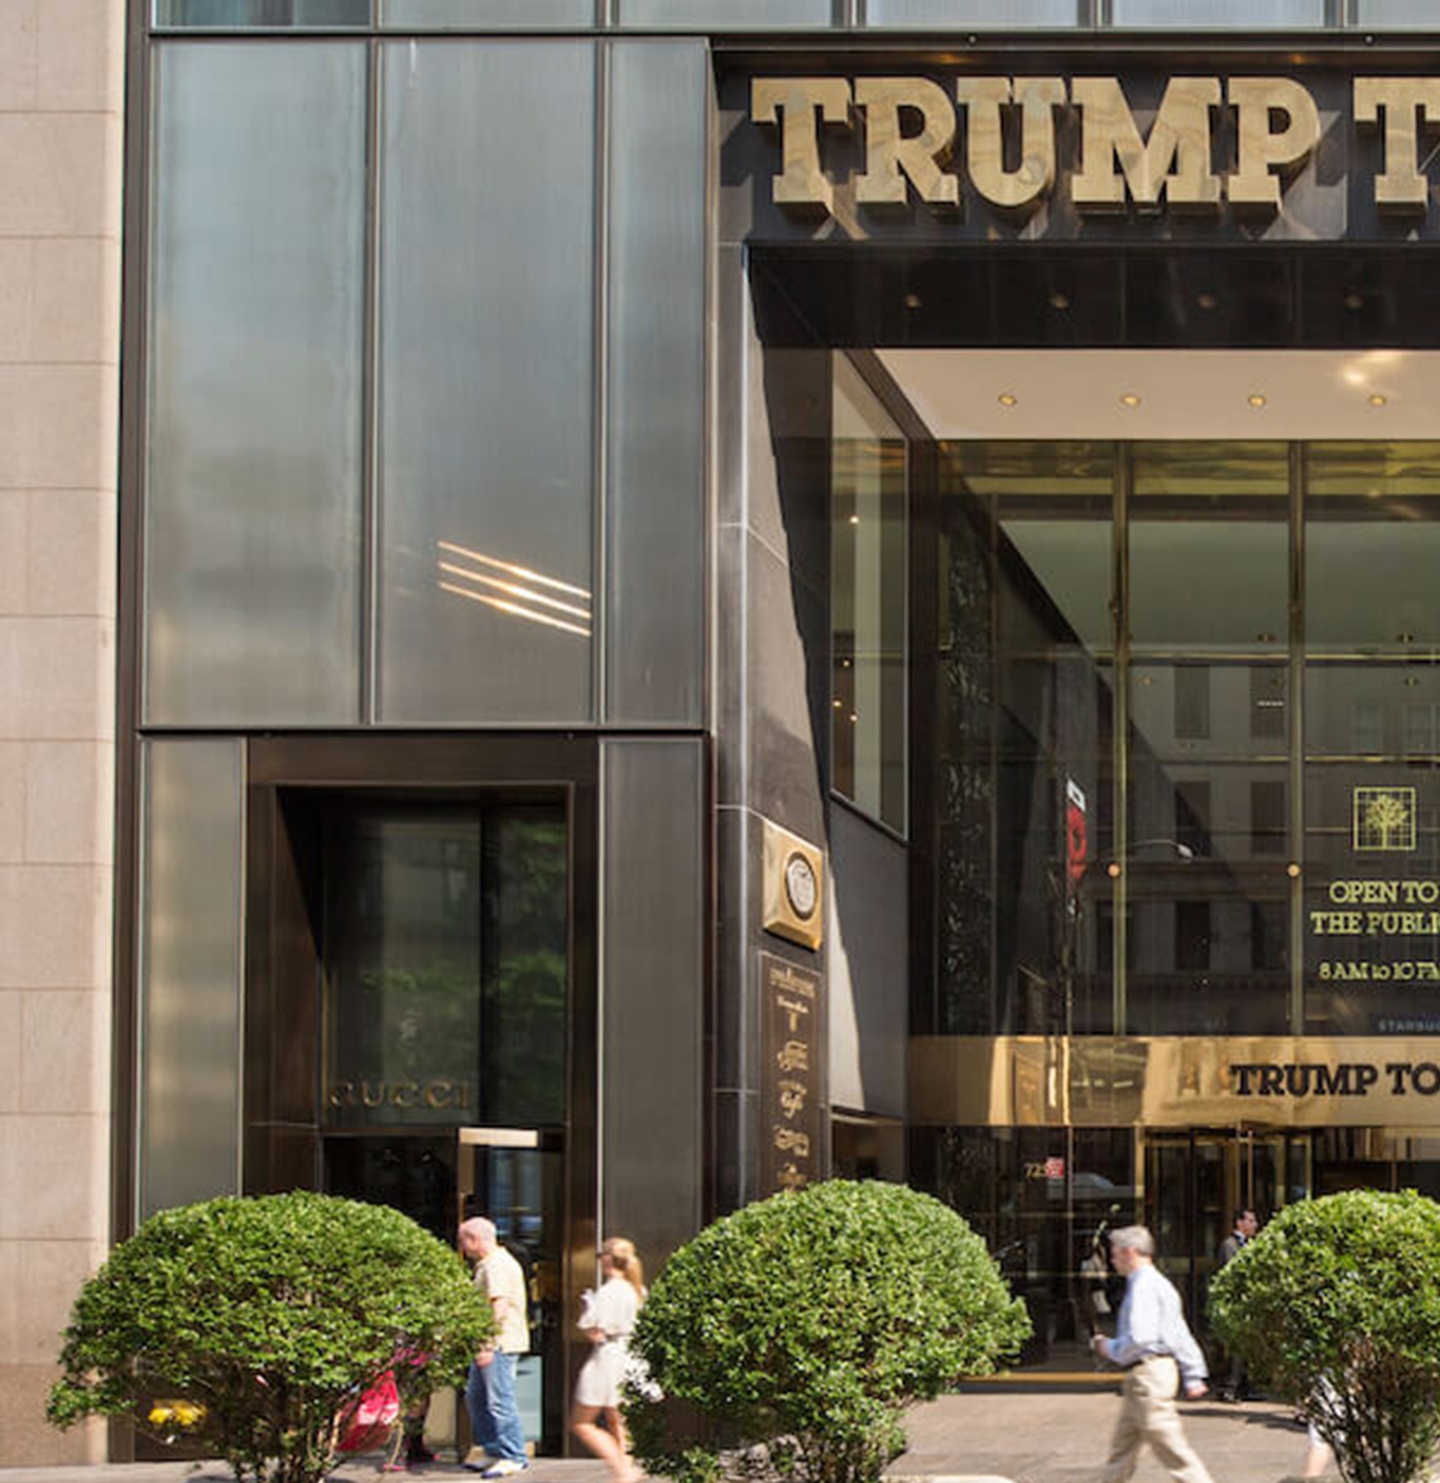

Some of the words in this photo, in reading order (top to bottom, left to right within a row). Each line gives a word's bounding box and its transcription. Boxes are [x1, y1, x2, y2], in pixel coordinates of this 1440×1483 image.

[750, 77, 1321, 207] TRUMP
[1329, 880, 1399, 904] OPEN
[1401, 880, 1440, 904] TO
[1310, 911, 1363, 935] THE
[1371, 963, 1391, 980] to
[1393, 961, 1415, 980] 10
[1231, 1063, 1378, 1097] TRUMP
[329, 1081, 469, 1109] GUCCI
